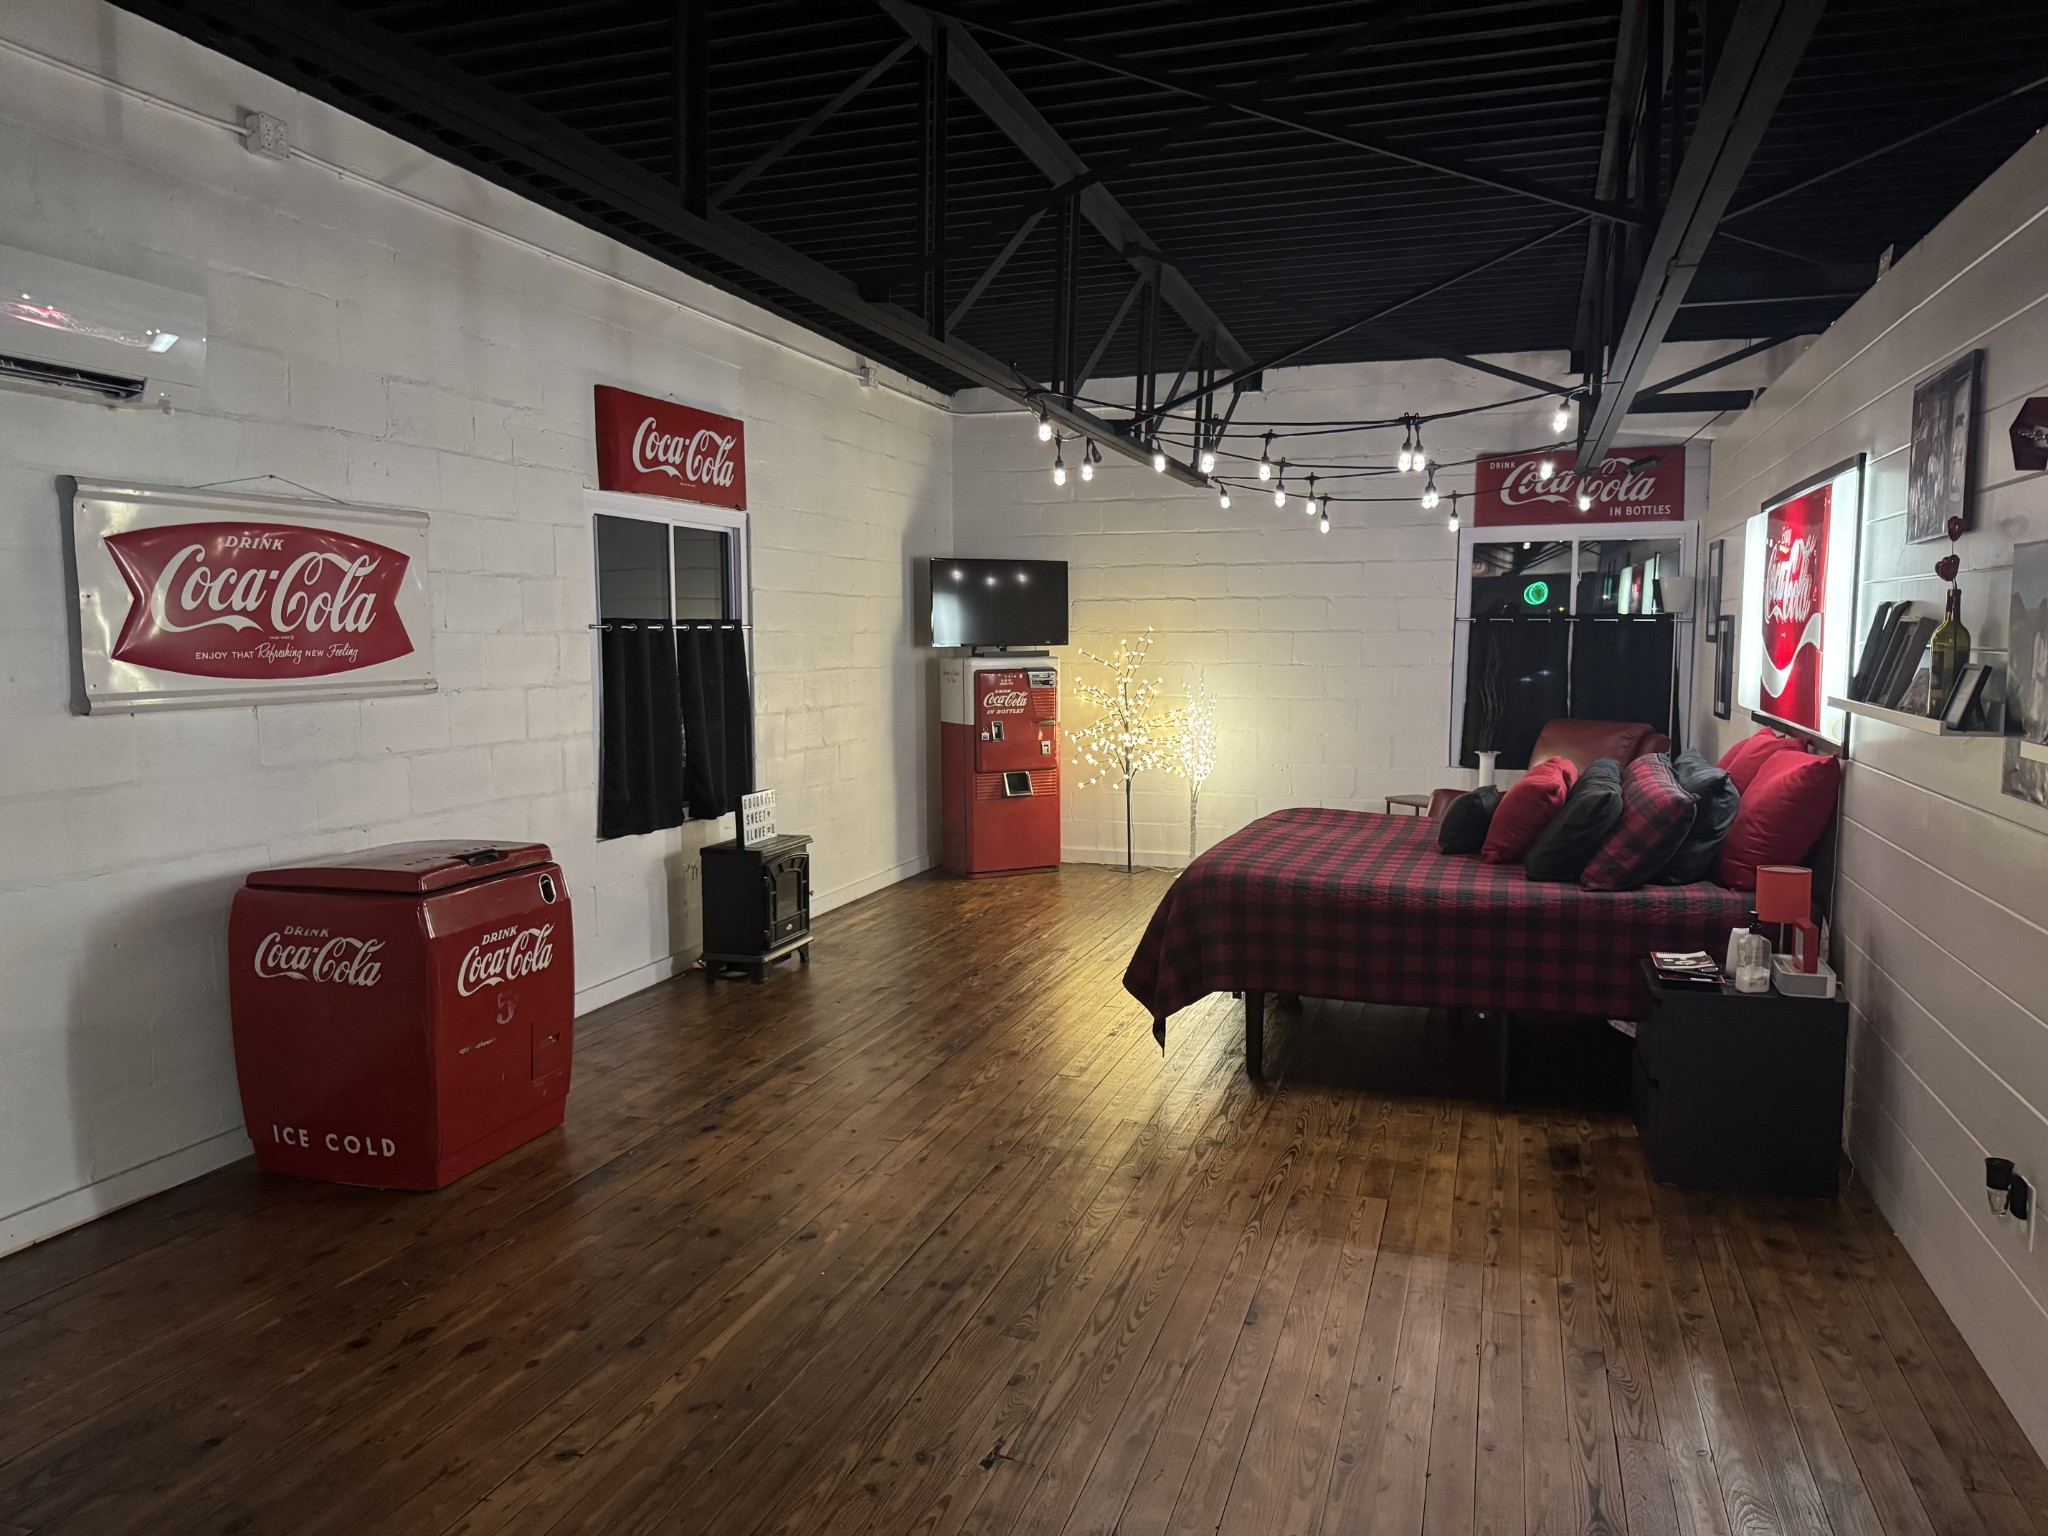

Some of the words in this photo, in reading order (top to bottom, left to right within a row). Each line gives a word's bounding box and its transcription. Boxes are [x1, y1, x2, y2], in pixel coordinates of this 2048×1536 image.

[632, 416, 737, 488] Coca-Cola
[1489, 461, 1516, 470] DRINK
[1499, 456, 1657, 507] CocaCola
[1609, 507, 1621, 517] IN
[1626, 504, 1671, 516] BOTTLES
[223, 535, 285, 551] DRINK
[150, 543, 382, 633] Coca-Cola
[195, 651, 228, 660] ENJOY
[231, 651, 255, 659] THAT
[255, 642, 303, 665] Refreshing
[305, 649, 325, 657] NEW
[326, 642, 359, 663] Feeling
[983, 690, 1029, 708] Coca-Cola
[746, 810, 766, 826] SWEET
[284, 924, 331, 938] DRINK
[481, 924, 518, 947] DRINK
[254, 931, 386, 988] Coca-Cola
[457, 922, 556, 998] Coca-Cola
[272, 1124, 310, 1148] ICE
[325, 1133, 396, 1157] COLD
